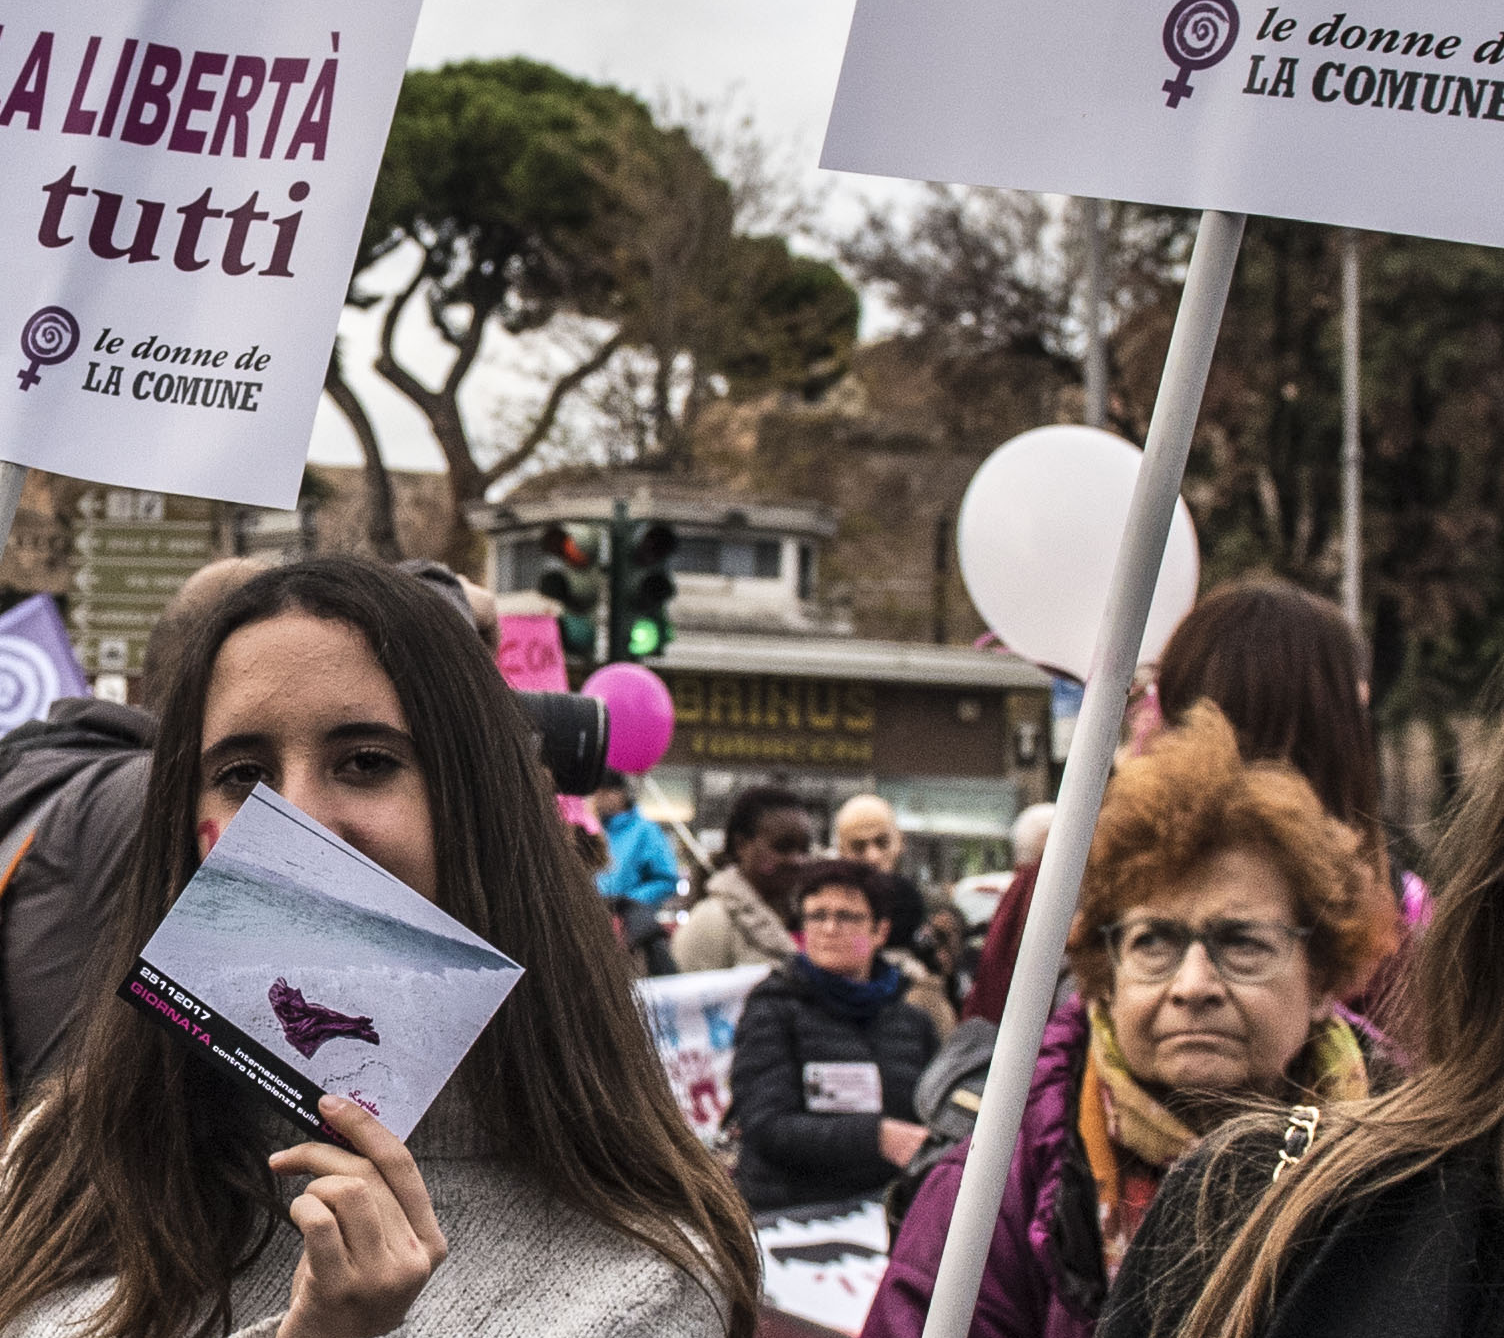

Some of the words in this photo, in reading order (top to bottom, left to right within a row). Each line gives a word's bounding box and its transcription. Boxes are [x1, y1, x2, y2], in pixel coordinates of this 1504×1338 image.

[1256, 6, 1297, 42] le
[1308, 13, 1462, 59] donne
[61, 31, 341, 162] LIBERTÀ
[1242, 55, 1299, 98] LA
[36, 165, 311, 279] tutti
[93, 328, 124, 355] le
[131, 335, 229, 368] donne
[234, 345, 271, 372] de
[81, 361, 124, 396] LA
[132, 370, 263, 412] COMUNE
[139, 966, 212, 1021] 25112017
[129, 981, 212, 1046] GIORNATA
[212, 1045, 246, 1072] contro
[247, 1069, 256, 1080] la
[258, 1077, 296, 1109] violenza
[297, 1107, 320, 1126] sulle
[235, 1047, 303, 1101] internazionale
